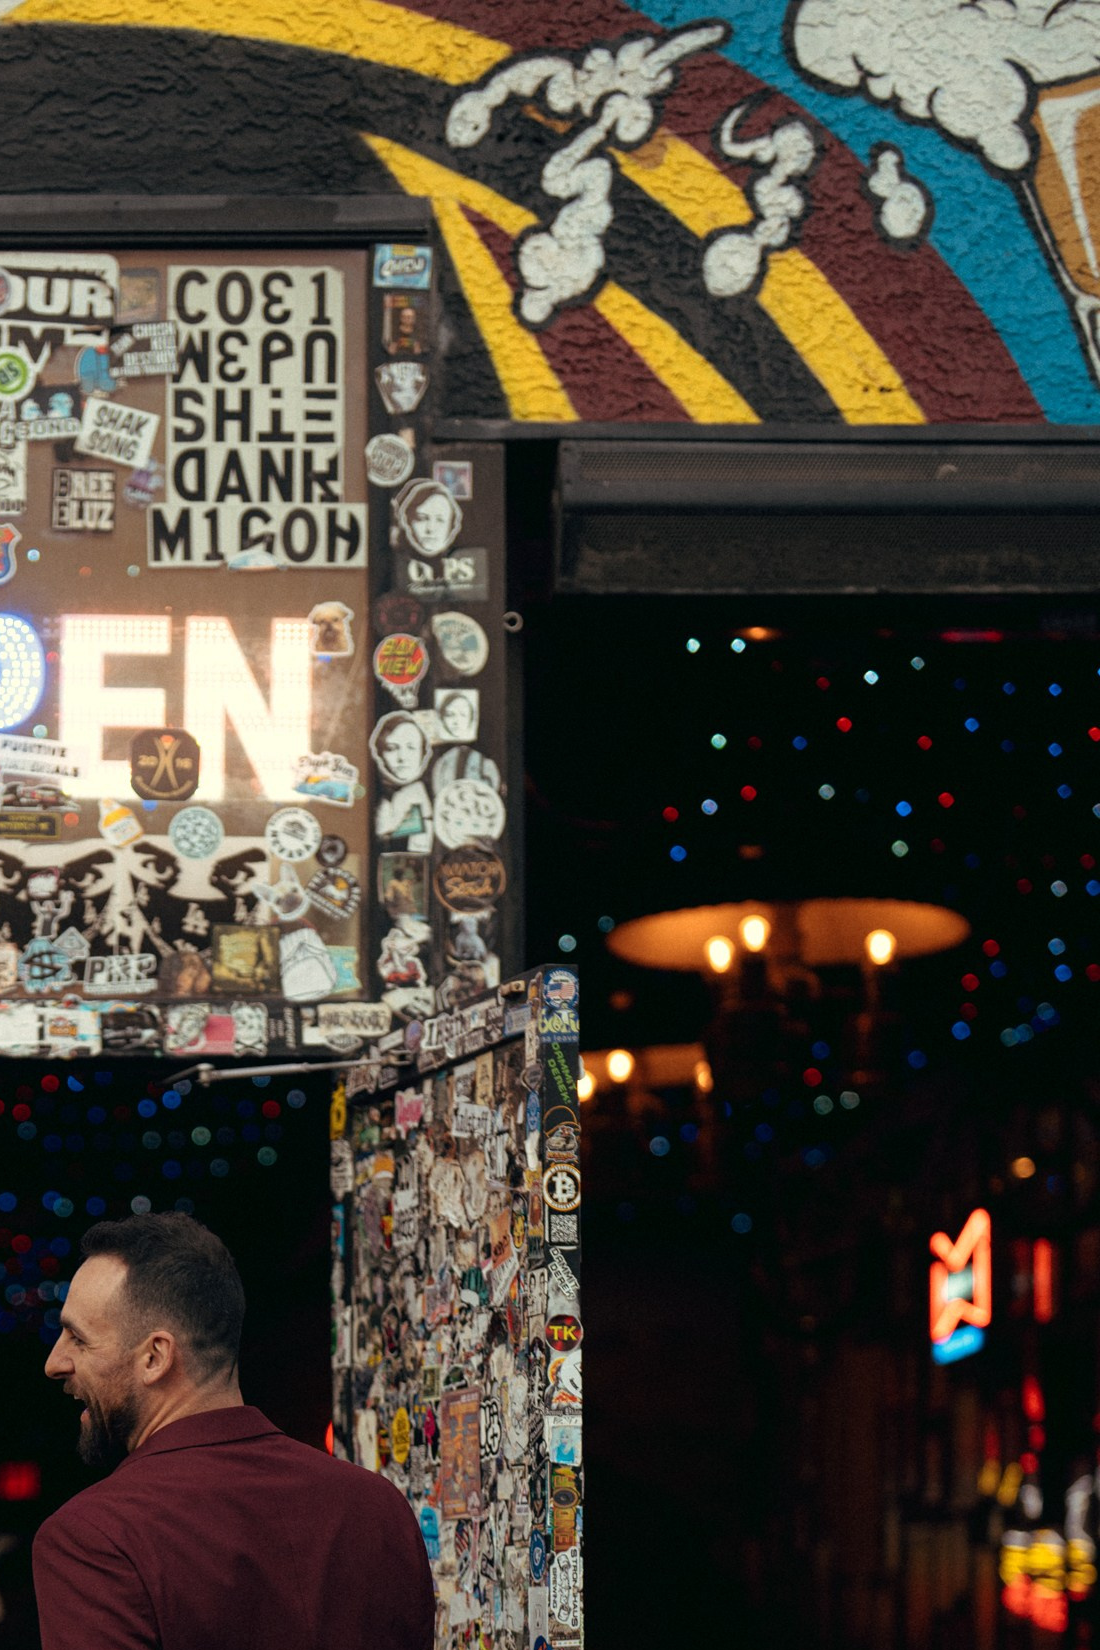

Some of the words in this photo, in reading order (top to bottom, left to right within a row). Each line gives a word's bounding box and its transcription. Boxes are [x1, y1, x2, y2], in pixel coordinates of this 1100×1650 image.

[93, 403, 150, 440] SHAK
[85, 430, 141, 462] SONG
[270, 829, 314, 860] NEVADA
[550, 1247, 579, 1290] DAMMIT
[549, 1325, 578, 1342] TK
[551, 1566, 559, 1611] BREWING
[569, 1547, 581, 1629] STRONHAUS
